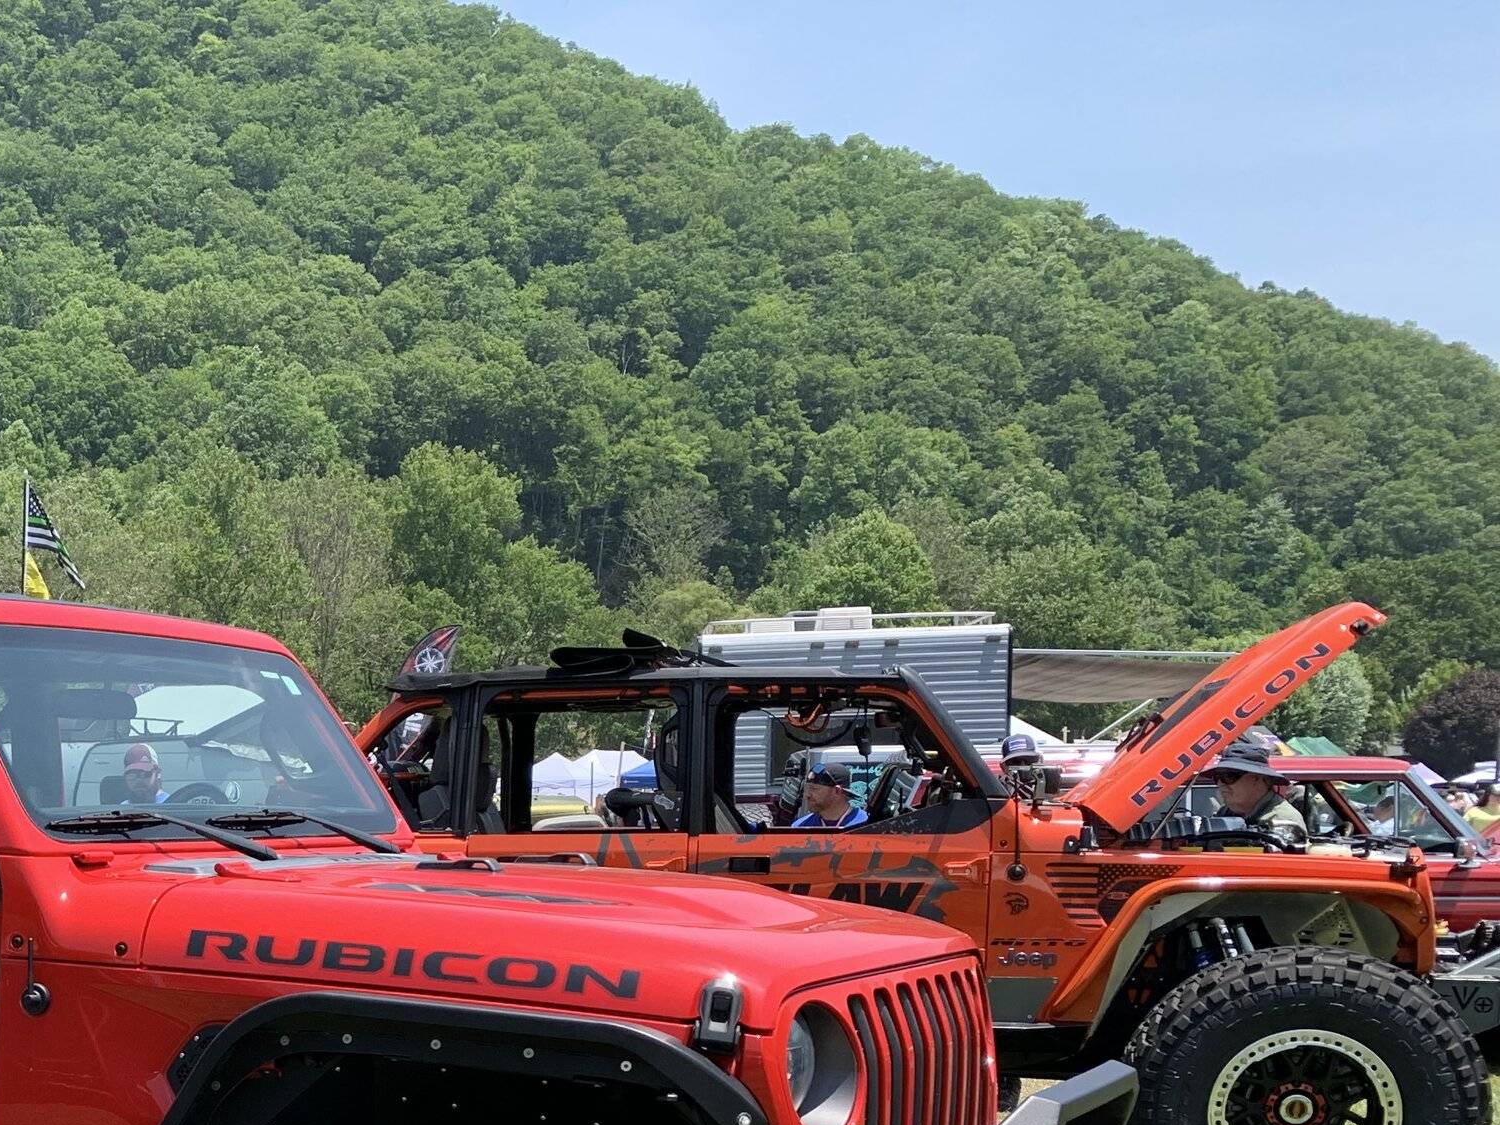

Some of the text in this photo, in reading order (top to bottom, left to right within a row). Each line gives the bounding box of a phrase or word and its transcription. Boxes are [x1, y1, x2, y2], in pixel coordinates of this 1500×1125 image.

[1131, 642, 1332, 808] RUBICON
[184, 929, 642, 1000] RUBICON
[997, 946, 1059, 970] Jeep
